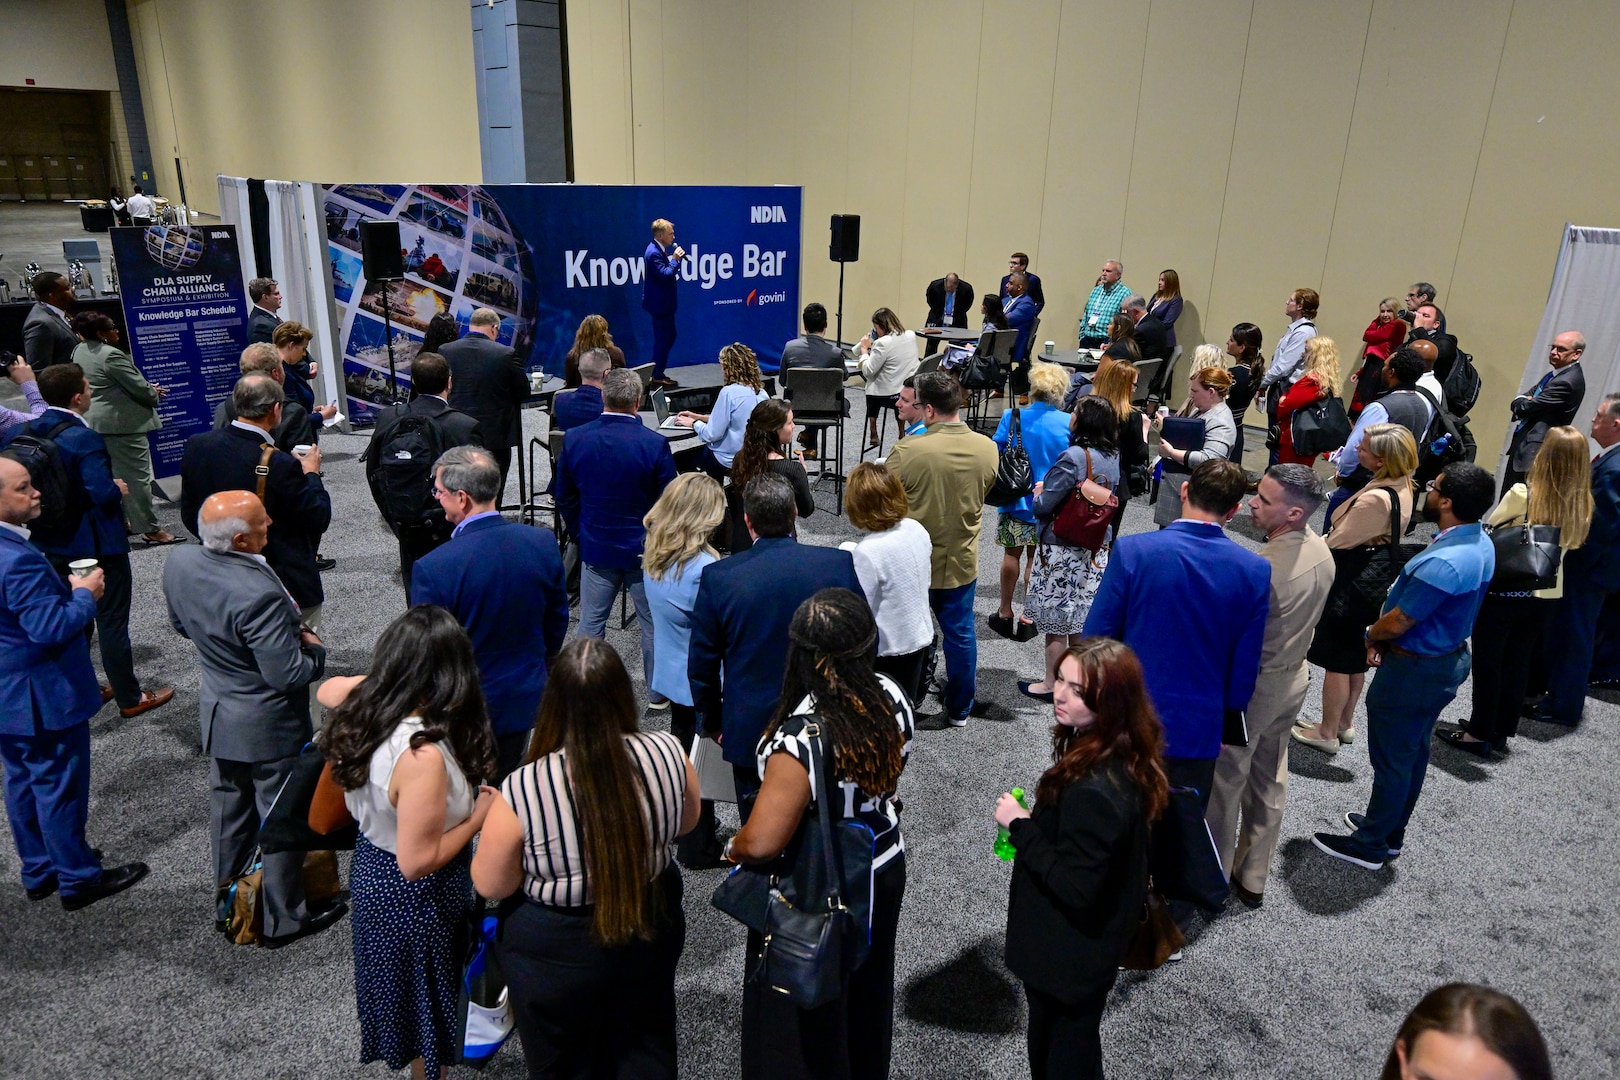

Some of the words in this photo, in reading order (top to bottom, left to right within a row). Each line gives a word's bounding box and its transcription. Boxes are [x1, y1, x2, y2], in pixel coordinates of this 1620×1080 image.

[750, 206, 787, 224] NDIA
[564, 244, 734, 290] Knowdge
[743, 244, 786, 278] Bar
[154, 277, 174, 286] DLA
[176, 274, 212, 285] SUPPLY
[142, 286, 177, 297] CHAIN
[180, 283, 225, 294] ALLIANCE
[141, 296, 183, 304] SYMPOSIUM
[759, 291, 785, 305] govini
[138, 310, 184, 321] Knowledge
[185, 308, 199, 317] Bar
[201, 305, 236, 316] Schedule
